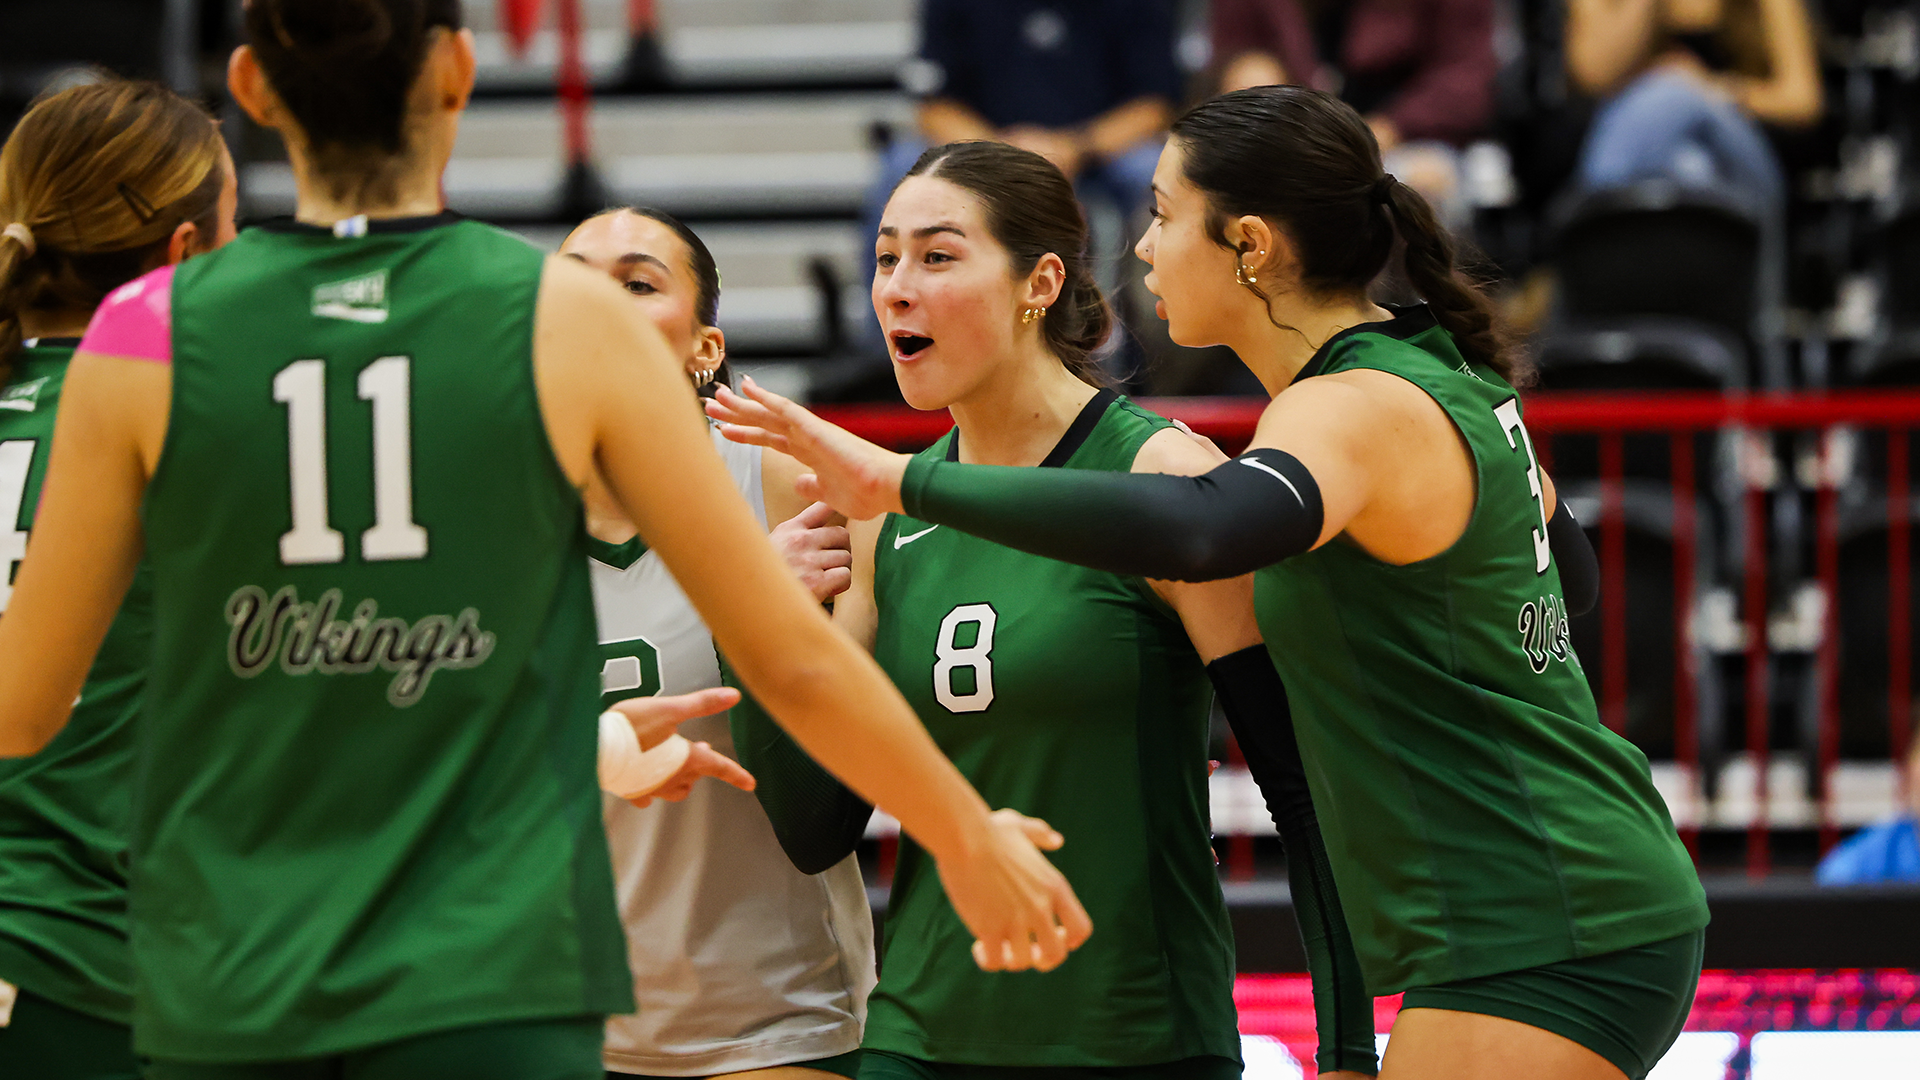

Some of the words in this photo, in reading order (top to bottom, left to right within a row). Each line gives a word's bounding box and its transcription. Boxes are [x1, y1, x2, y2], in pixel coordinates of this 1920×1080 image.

[273, 355, 429, 566] 11
[1492, 394, 1550, 577] 3
[225, 585, 496, 708] Vikings
[932, 601, 999, 714] 8
